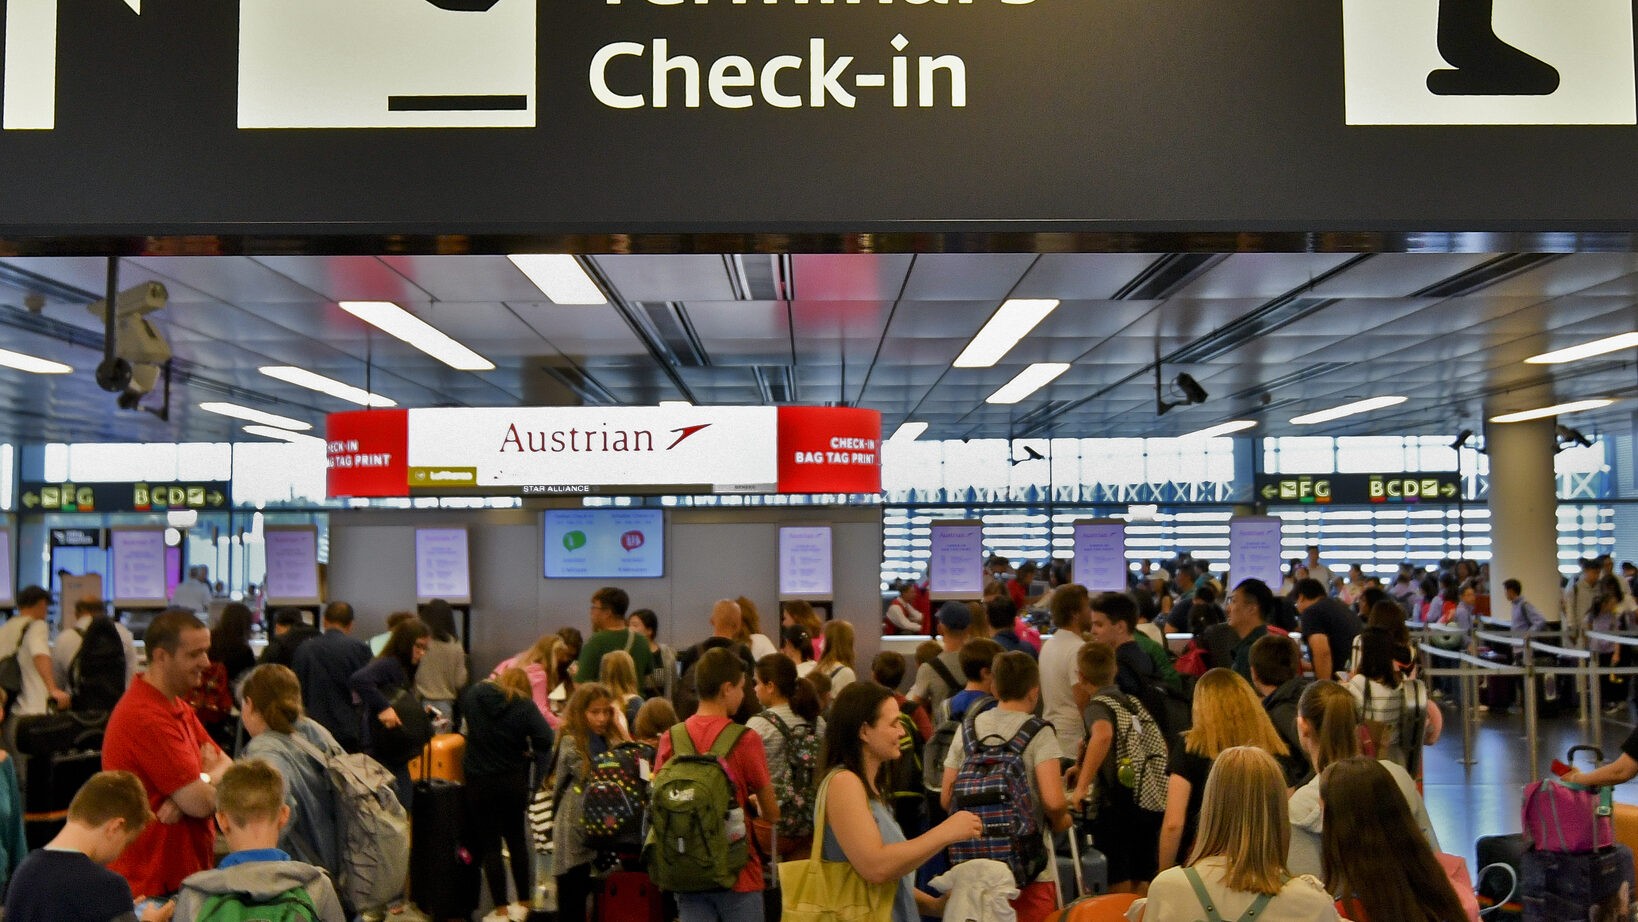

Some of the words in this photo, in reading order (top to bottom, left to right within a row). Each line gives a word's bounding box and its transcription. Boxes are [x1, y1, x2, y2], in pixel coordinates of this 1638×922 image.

[589, 33, 967, 109] Check-in
[499, 422, 654, 452] Austrian
[830, 436, 875, 450] CHECK-IN
[335, 454, 353, 468] TAG
[354, 453, 392, 467] PRINT
[795, 451, 824, 464] BAG
[825, 451, 850, 464] TAG
[851, 453, 875, 464] PRINT
[523, 485, 545, 493] STAR
